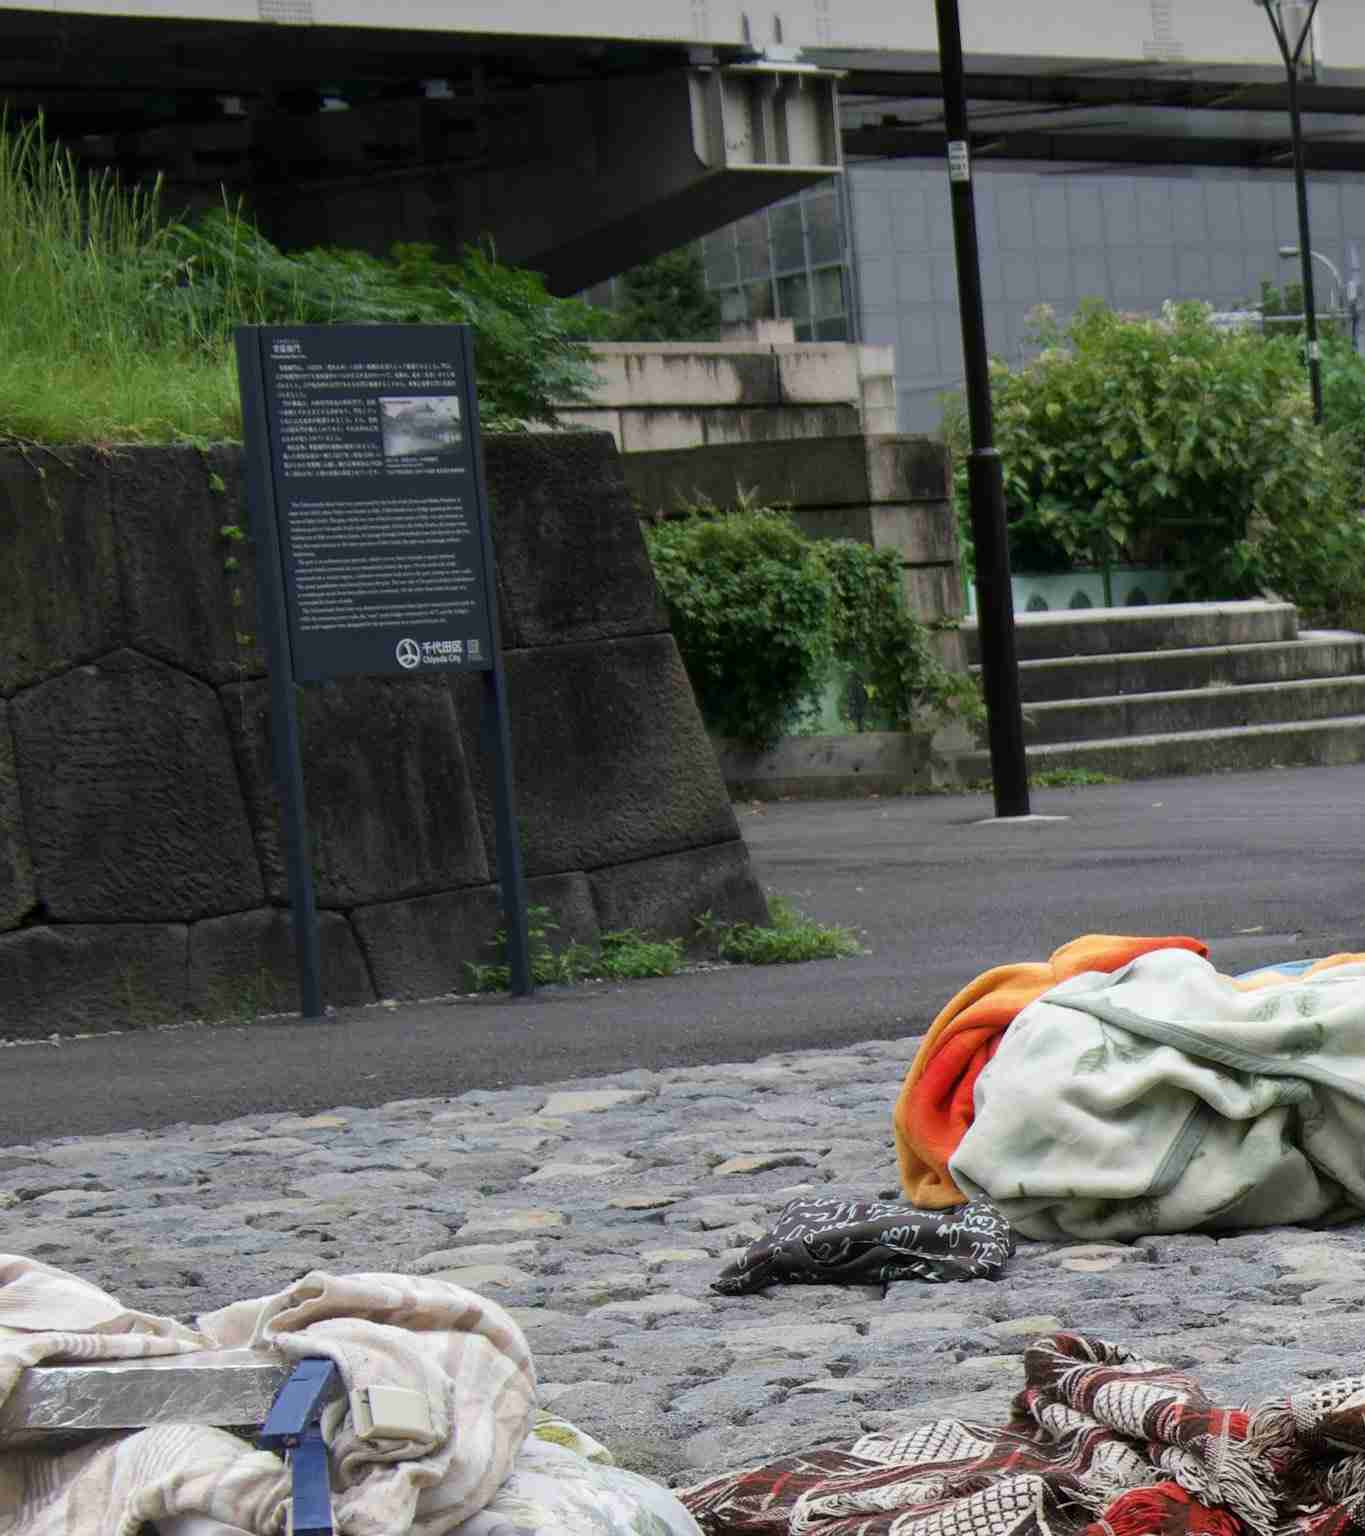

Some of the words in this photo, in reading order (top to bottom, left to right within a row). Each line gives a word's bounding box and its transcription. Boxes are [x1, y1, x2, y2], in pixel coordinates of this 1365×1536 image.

[422, 640, 462, 655] 千代田区
[448, 655, 461, 665] City
